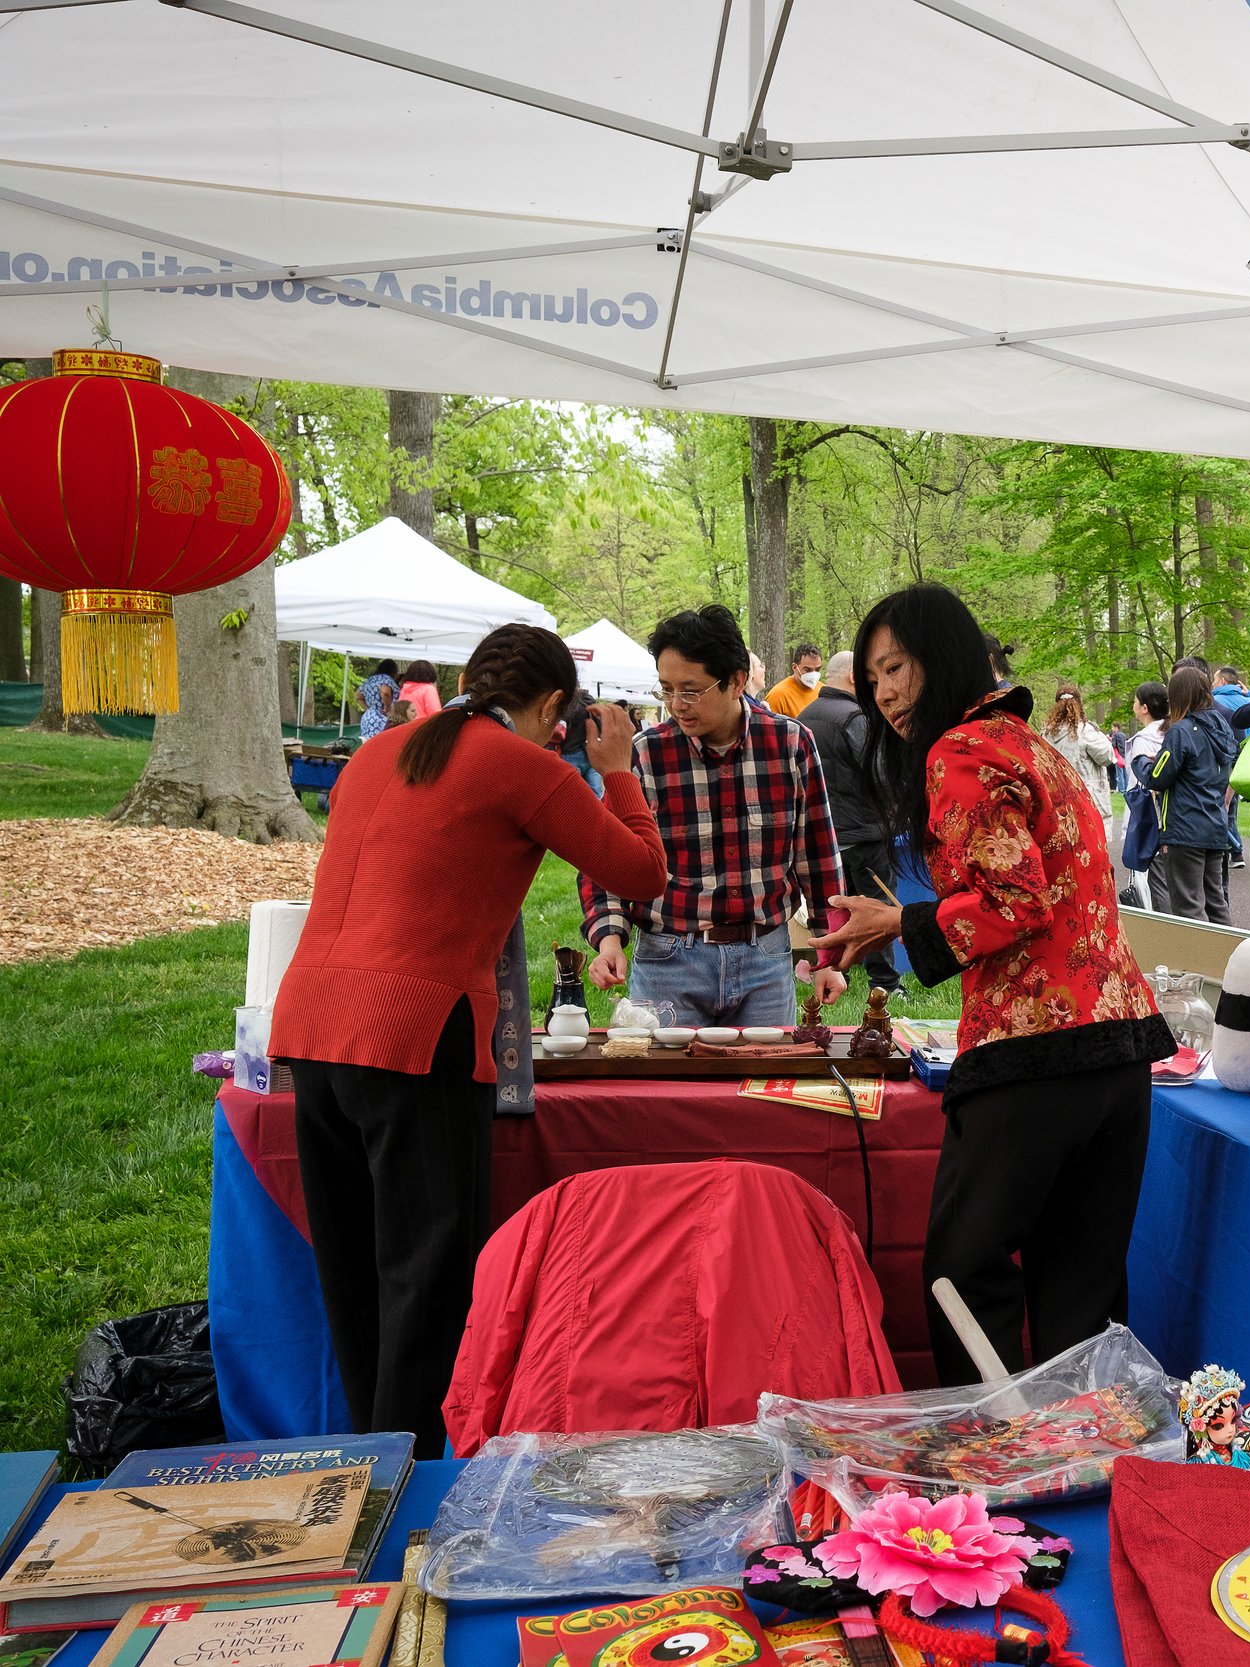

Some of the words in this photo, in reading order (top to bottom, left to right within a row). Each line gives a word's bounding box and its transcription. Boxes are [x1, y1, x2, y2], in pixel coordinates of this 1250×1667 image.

[147, 1465, 209, 1477] BEST
[212, 1458, 324, 1475] SCENERY
[328, 1455, 379, 1467] AND
[154, 1472, 241, 1486] SIGHTS
[250, 1472, 278, 1481] IN
[349, 1590, 378, 1606] 安
[150, 1606, 184, 1624] 道
[560, 1589, 744, 1636] Coloring
[213, 1621, 237, 1629] THE
[240, 1614, 304, 1630] SPIRIT
[227, 1630, 244, 1638] OF
[251, 1627, 276, 1635] THE
[198, 1633, 293, 1652] CHINESE
[174, 1641, 305, 1667] CHARACTER
